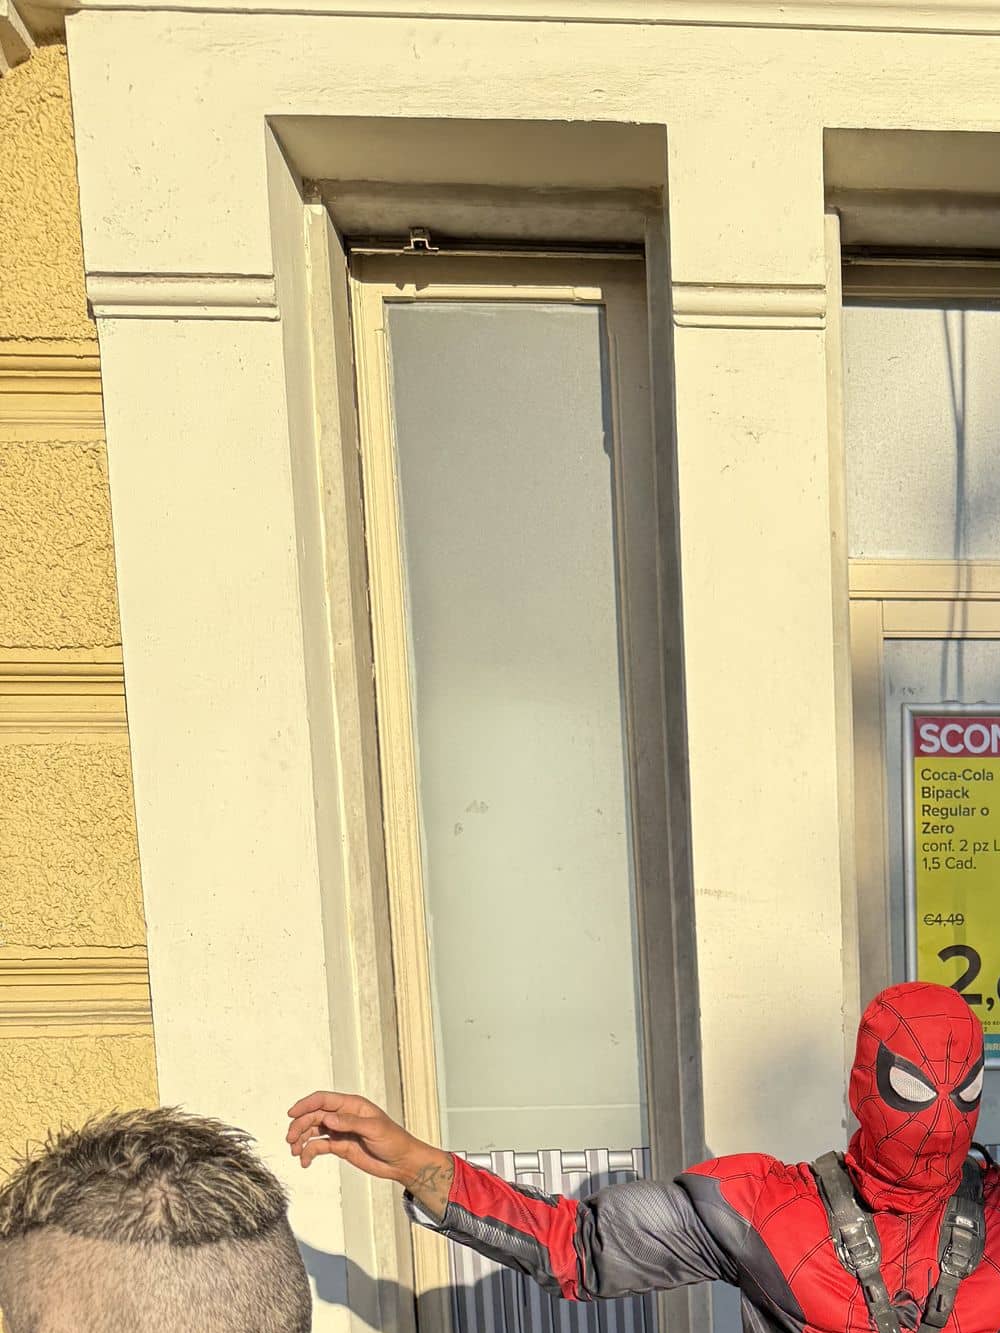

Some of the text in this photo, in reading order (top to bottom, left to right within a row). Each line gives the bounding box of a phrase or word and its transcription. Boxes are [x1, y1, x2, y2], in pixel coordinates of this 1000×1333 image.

[920, 768, 994, 782] Coca-Cola
[921, 786, 970, 800] Bipack
[921, 804, 990, 818] Regular o
[921, 822, 955, 835] Zero
[922, 839, 1000, 855] conf. 2 pz L
[922, 857, 977, 871] 1,5 Cad.
[923, 913, 965, 926] €4,49
